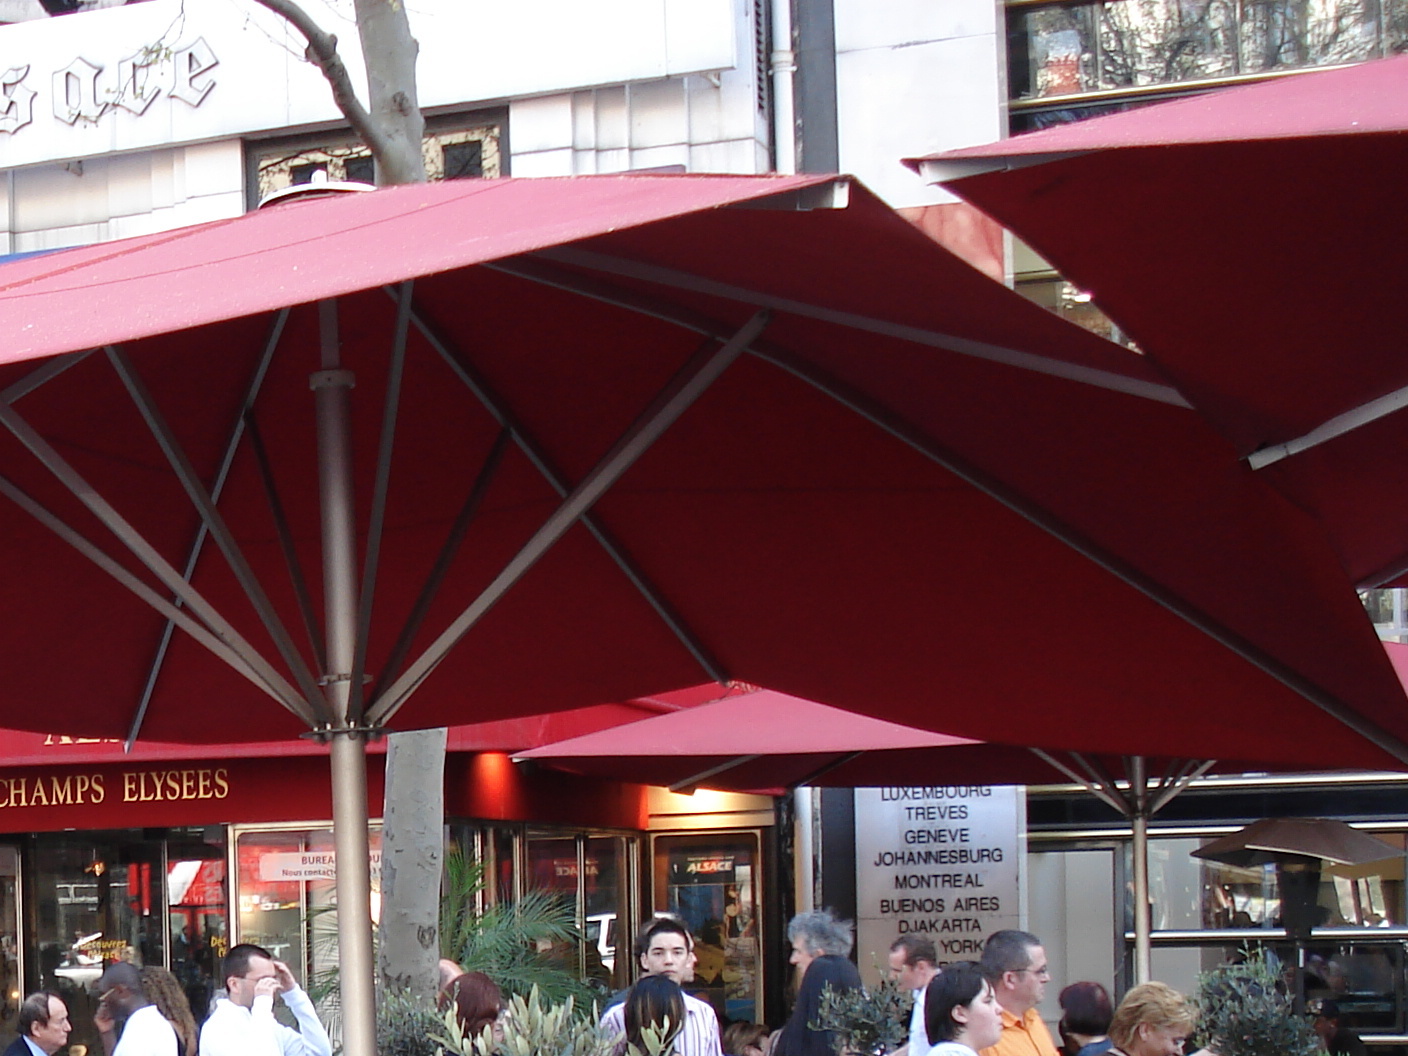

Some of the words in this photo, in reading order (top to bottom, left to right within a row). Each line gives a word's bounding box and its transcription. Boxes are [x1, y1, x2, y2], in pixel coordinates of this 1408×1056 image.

[123, 768, 229, 803] ELYSEES
[881, 785, 992, 801] LUXEMBOURG
[905, 805, 969, 821] TREVES
[904, 828, 970, 844] GENEVE
[301, 855, 336, 865] BUREA
[874, 848, 1004, 867] JOHANNESBURG
[686, 860, 732, 872] ALSACE
[895, 874, 984, 889] MONTREAL
[880, 898, 946, 913] BUENOS
[953, 897, 1000, 912] AIRES
[898, 919, 982, 934] DJAKARTA
[940, 940, 984, 954] YORK
